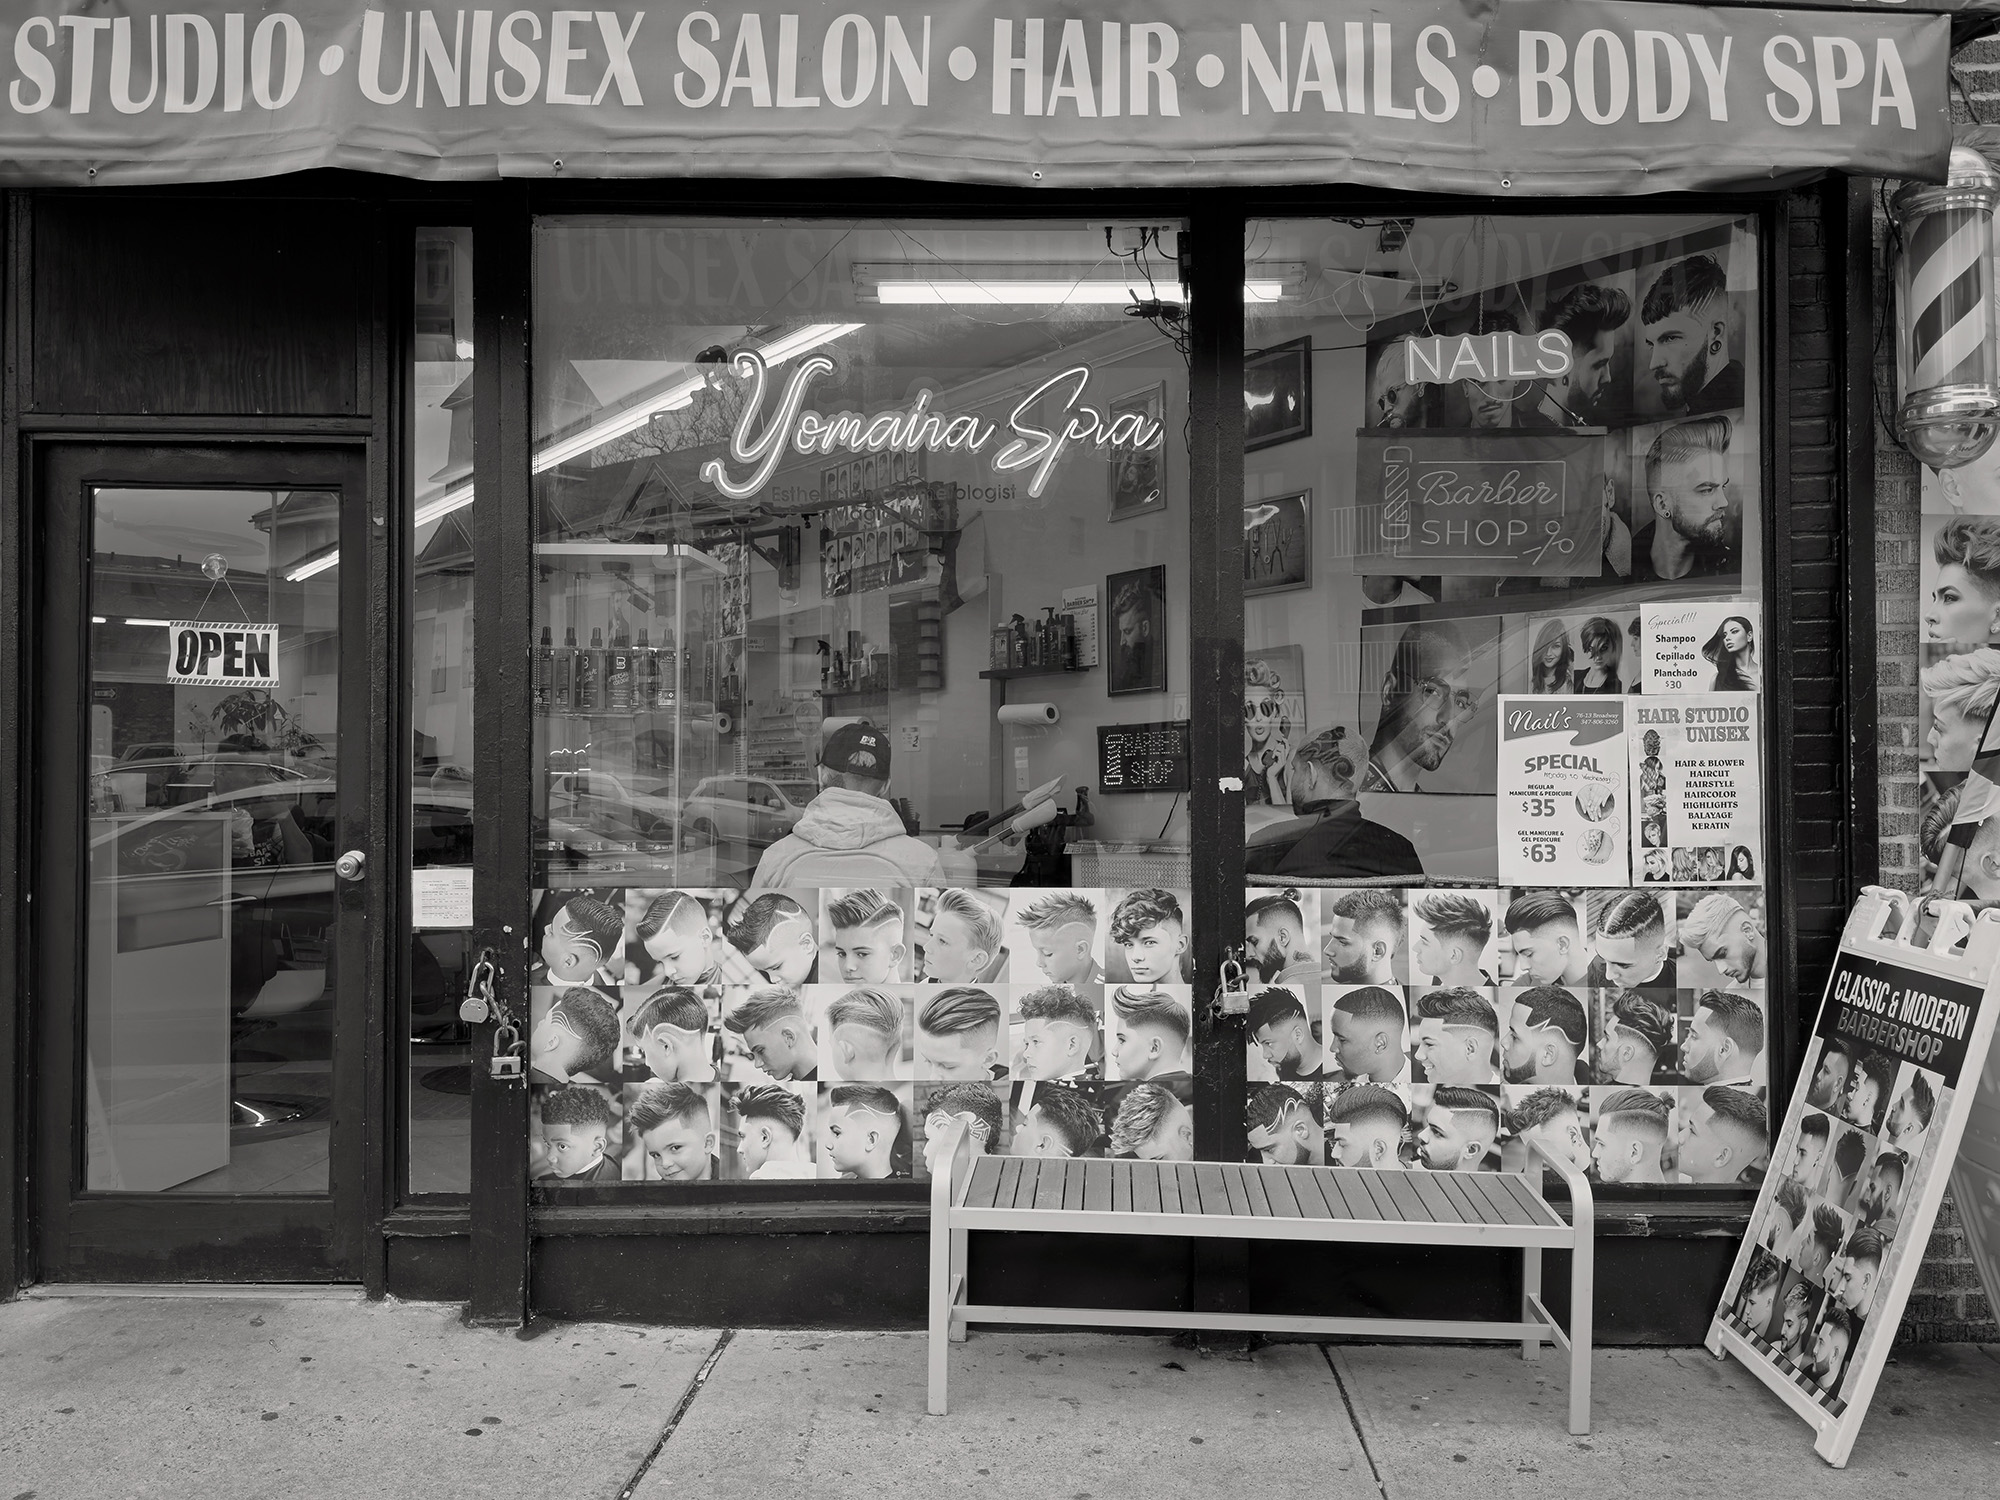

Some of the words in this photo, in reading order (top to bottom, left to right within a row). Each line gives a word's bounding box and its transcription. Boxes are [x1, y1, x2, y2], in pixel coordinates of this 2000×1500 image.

[9, 13, 304, 115] STUDIO
[358, 10, 644, 108] UNISEX
[673, 11, 931, 108] SALON
[992, 18, 1181, 118] HAIR
[1241, 21, 1460, 123] NAILS
[1518, 29, 1732, 126] BODY
[1763, 35, 1917, 130] SPA
[1406, 329, 1571, 381] NAILS
[704, 351, 996, 494] Yomaira
[996, 366, 1162, 493] Spa
[1417, 470, 1559, 506] Barber
[1419, 519, 1528, 547] SHOP
[1655, 634, 1696, 644] Shampoo
[175, 629, 271, 678] OPEN
[1655, 652, 1696, 662] Cepillado
[1654, 669, 1698, 677] Planchado
[1665, 680, 1682, 689] $30
[1508, 706, 1572, 732] Nail's
[1637, 708, 1681, 724] HAIR
[1685, 706, 1749, 724] STUDIO
[1124, 730, 1181, 757] BARBER
[1685, 726, 1750, 743] UNISEX
[1130, 759, 1174, 784] SHOP
[1524, 754, 1604, 774] SPECIAL
[1708, 759, 1745, 767] BLOWER
[1685, 780, 1735, 788] HAIRSTYLE
[1522, 798, 1556, 817] $35
[1682, 801, 1739, 809] HIGHLIGHTS
[1688, 811, 1733, 819] BALAYAGE
[1692, 822, 1730, 830] KERATIN
[1522, 844, 1557, 863] $63
[1834, 970, 1890, 1015] CLASSIC
[1888, 991, 1900, 1019] &
[1899, 989, 1971, 1041] MODERN
[1837, 1006, 1944, 1064] BARBERSHOP
